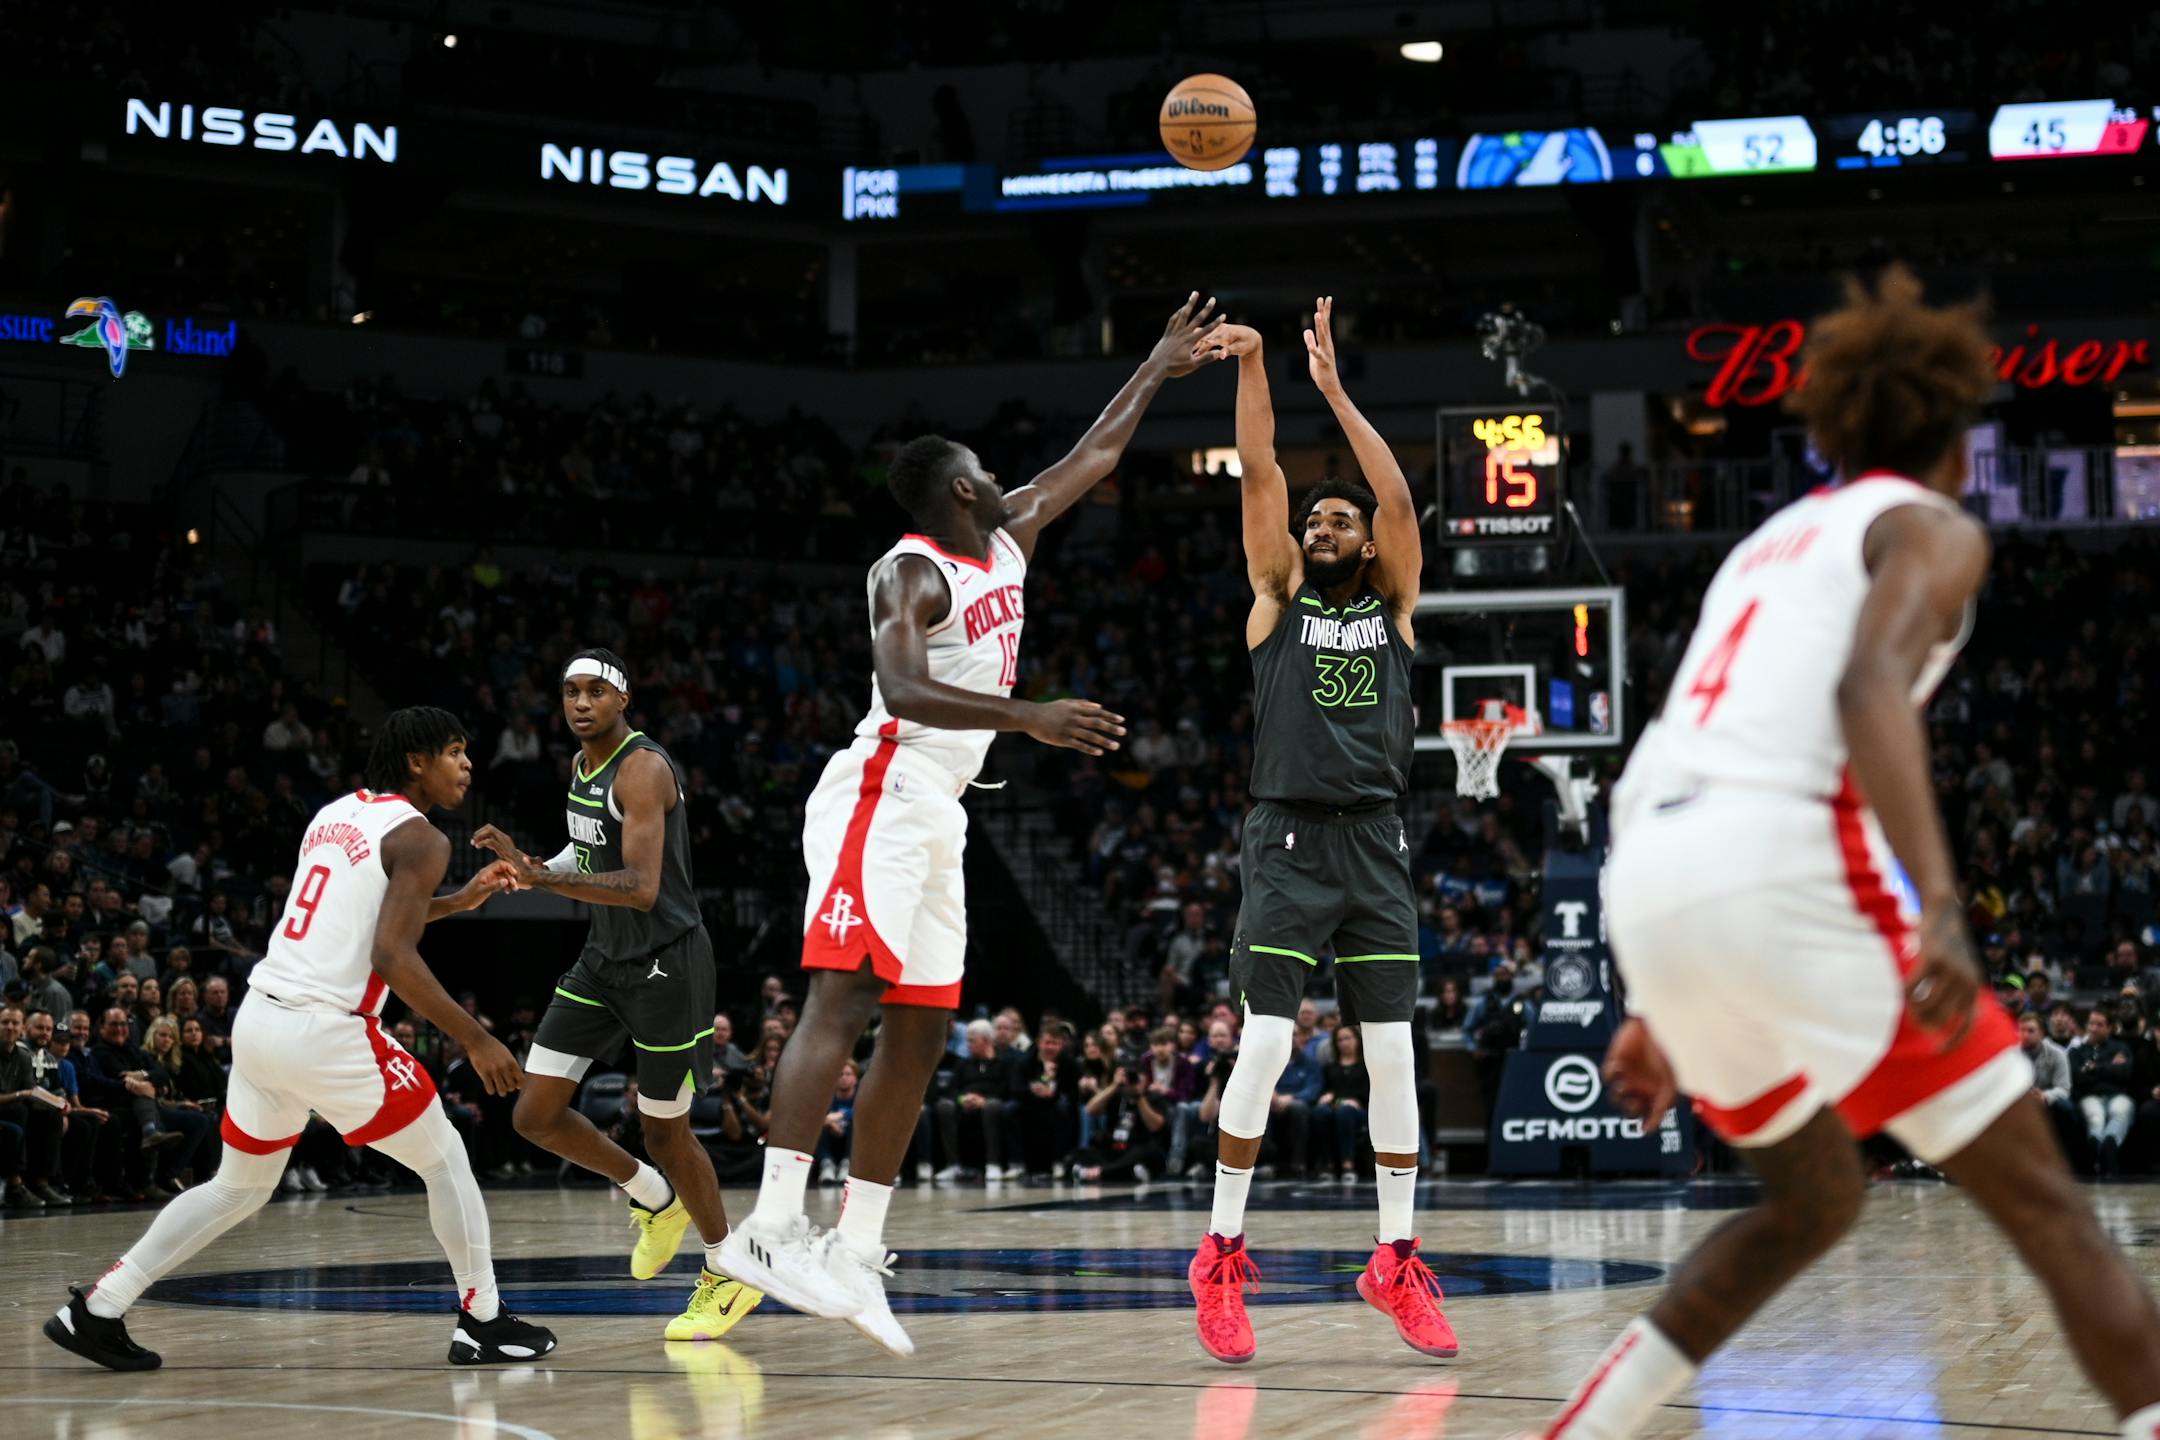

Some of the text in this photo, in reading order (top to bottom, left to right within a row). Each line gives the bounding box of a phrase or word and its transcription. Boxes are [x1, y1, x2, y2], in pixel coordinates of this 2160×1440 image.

[1168, 97, 1229, 118] Wilson
[126, 98, 398, 163] NISSAN
[1744, 133, 1785, 170] 52
[1857, 116, 1946, 157] 4:56
[2023, 118, 2067, 152] 45
[541, 143, 788, 206] NISSAN
[1002, 163, 1252, 196] MINNESOTA TIMBERWOLVES
[0, 313, 237, 356] sure Island
[1686, 318, 2150, 408] Biser
[1473, 414, 1546, 451] 4:56
[1486, 450, 1537, 508] 15
[1476, 515, 1552, 535] TISSOT
[964, 585, 1024, 646] ROCKE
[1312, 655, 1378, 707] 32
[1688, 597, 1760, 728] 4
[302, 822, 371, 868] CHRISTOPHER
[283, 864, 331, 941] 9
[1502, 1117, 1646, 1142] CFMOTO
